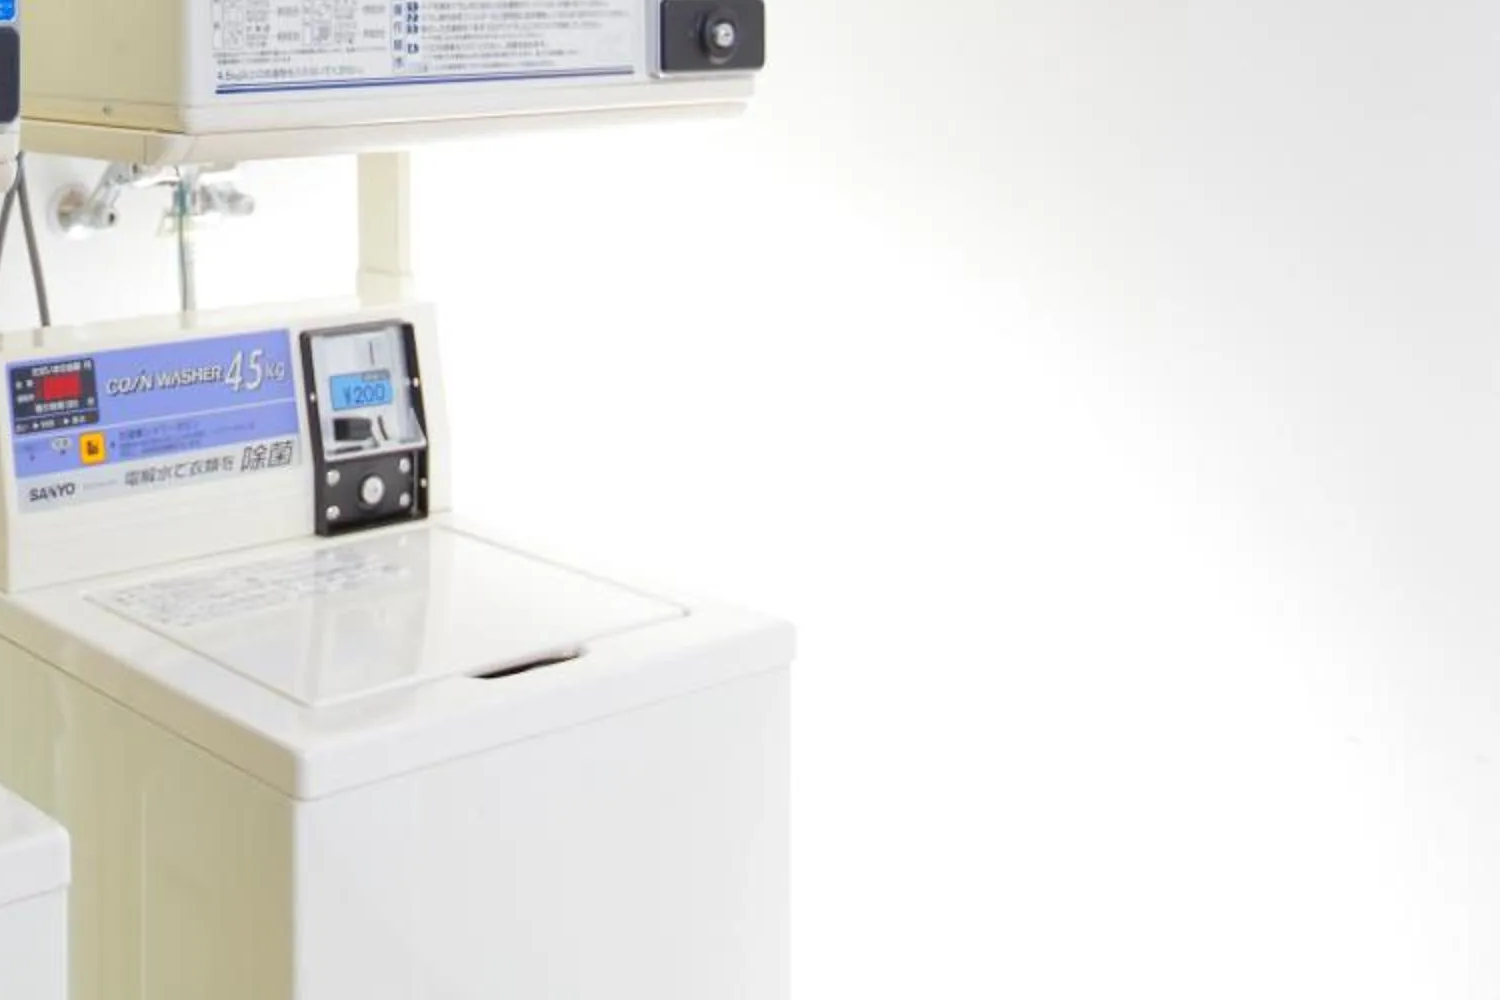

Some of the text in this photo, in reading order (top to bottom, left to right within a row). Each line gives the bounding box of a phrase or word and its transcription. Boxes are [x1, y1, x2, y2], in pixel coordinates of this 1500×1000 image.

[155, 365, 224, 389] WASHER
[240, 440, 294, 473] 除菌
[29, 482, 76, 502] SANYO
